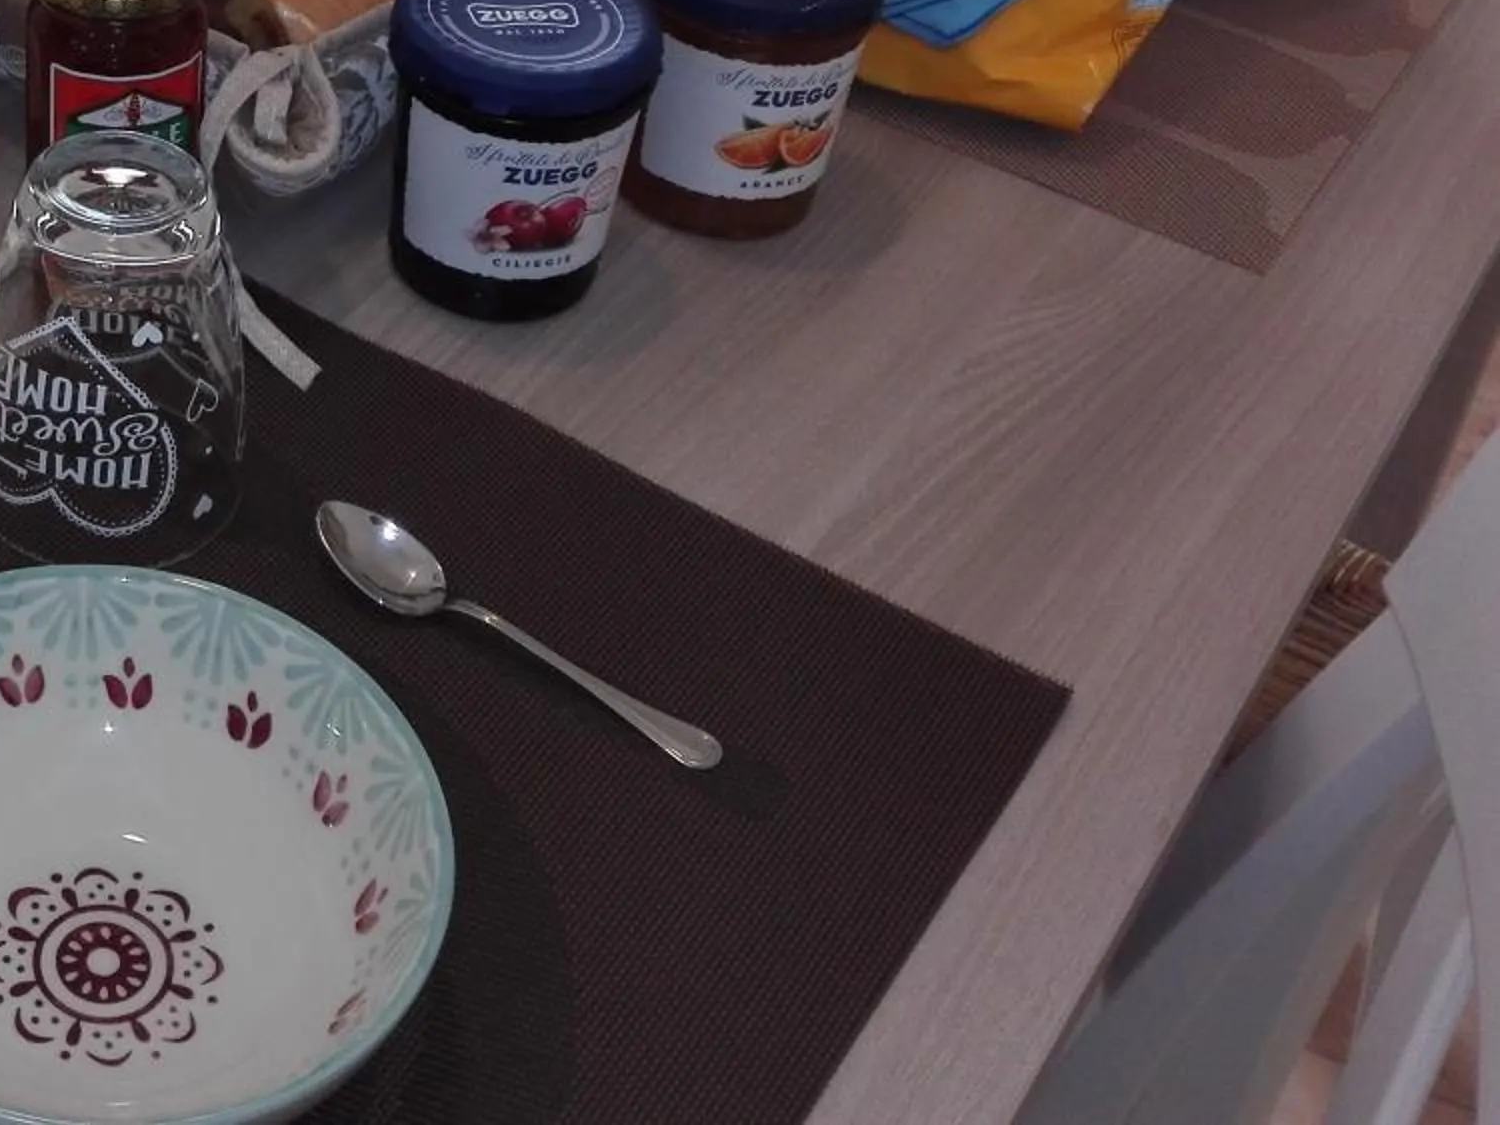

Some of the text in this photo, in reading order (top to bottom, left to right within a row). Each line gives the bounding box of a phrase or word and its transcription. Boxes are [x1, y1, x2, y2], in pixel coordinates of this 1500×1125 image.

[476, 7, 570, 23] ZUEGG
[751, 81, 839, 108] ZUEGG
[502, 161, 598, 187] ZUEGG
[22, 443, 153, 490] HOME
